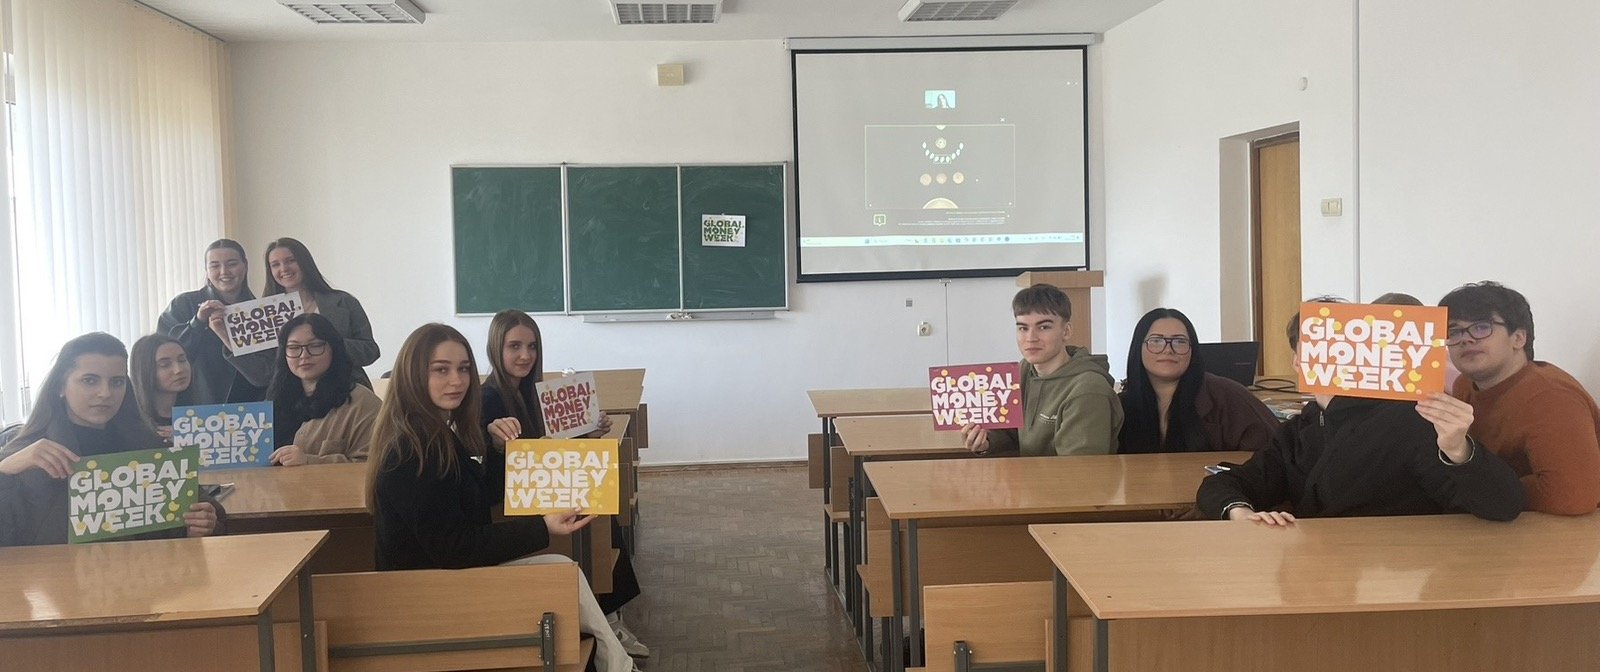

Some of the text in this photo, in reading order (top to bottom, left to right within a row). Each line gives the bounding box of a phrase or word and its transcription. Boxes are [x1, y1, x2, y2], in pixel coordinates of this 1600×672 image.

[704, 220, 744, 228] GLOBAL
[227, 300, 302, 325] GLOBAL
[232, 328, 281, 347] WEE
[1301, 316, 1445, 346] GLOBAL
[1300, 340, 1431, 369] MONEY
[931, 372, 1020, 394] GLOBAL
[1300, 362, 1406, 393] WEEK
[541, 382, 595, 405] GLOBAL
[932, 389, 1012, 409] MONEY
[543, 396, 591, 421] MONEY
[933, 406, 999, 426] WEEK
[173, 412, 273, 434] GLOBAL
[546, 412, 587, 434] WEEK
[173, 428, 264, 449] MONEY
[168, 446, 248, 467] EEK
[507, 451, 618, 469] GLOBAL
[69, 458, 197, 494] GLOBAL
[507, 469, 607, 488] MONEY
[70, 479, 186, 516] MONEY
[506, 488, 590, 508] WEEK
[69, 502, 166, 537] WEEK
